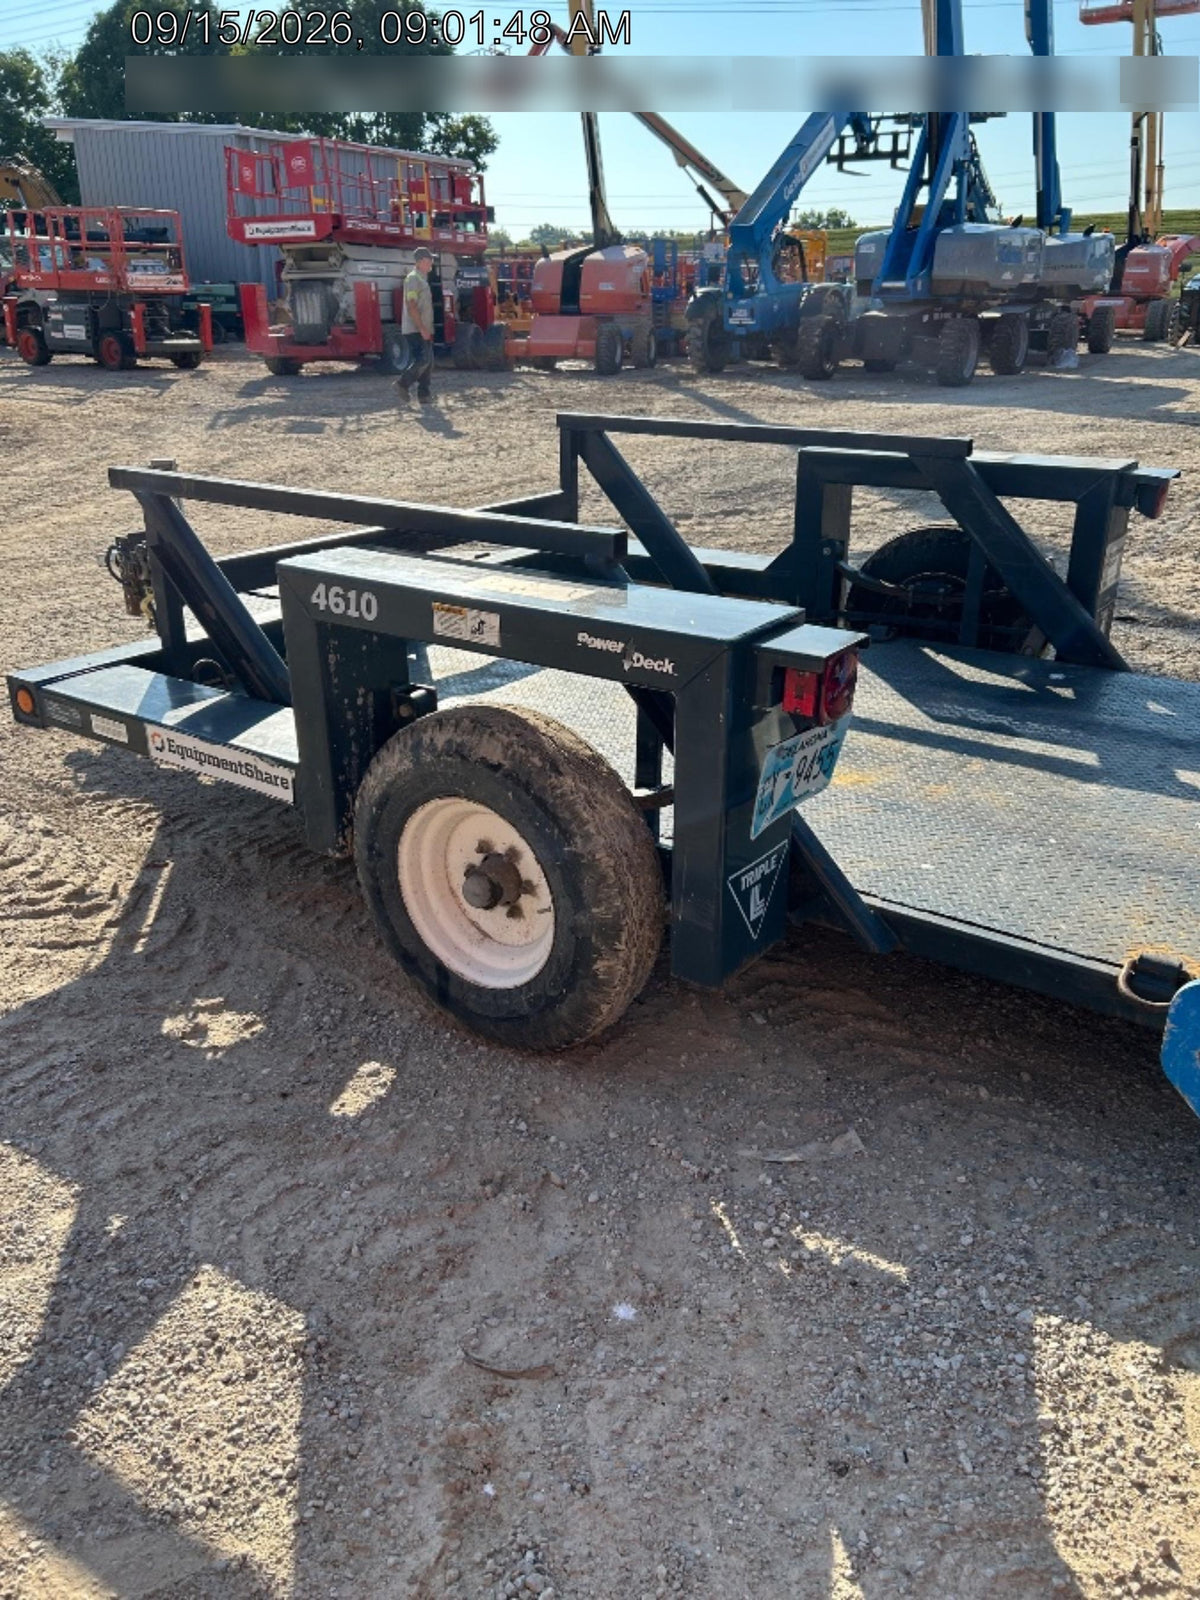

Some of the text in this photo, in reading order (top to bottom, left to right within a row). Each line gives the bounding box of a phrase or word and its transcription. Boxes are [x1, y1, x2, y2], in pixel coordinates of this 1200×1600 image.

[311, 583, 378, 621] 4610
[577, 632, 675, 675] Power Deck
[166, 737, 289, 790] EquipmentShare
[741, 854, 778, 891] TRIPLE
